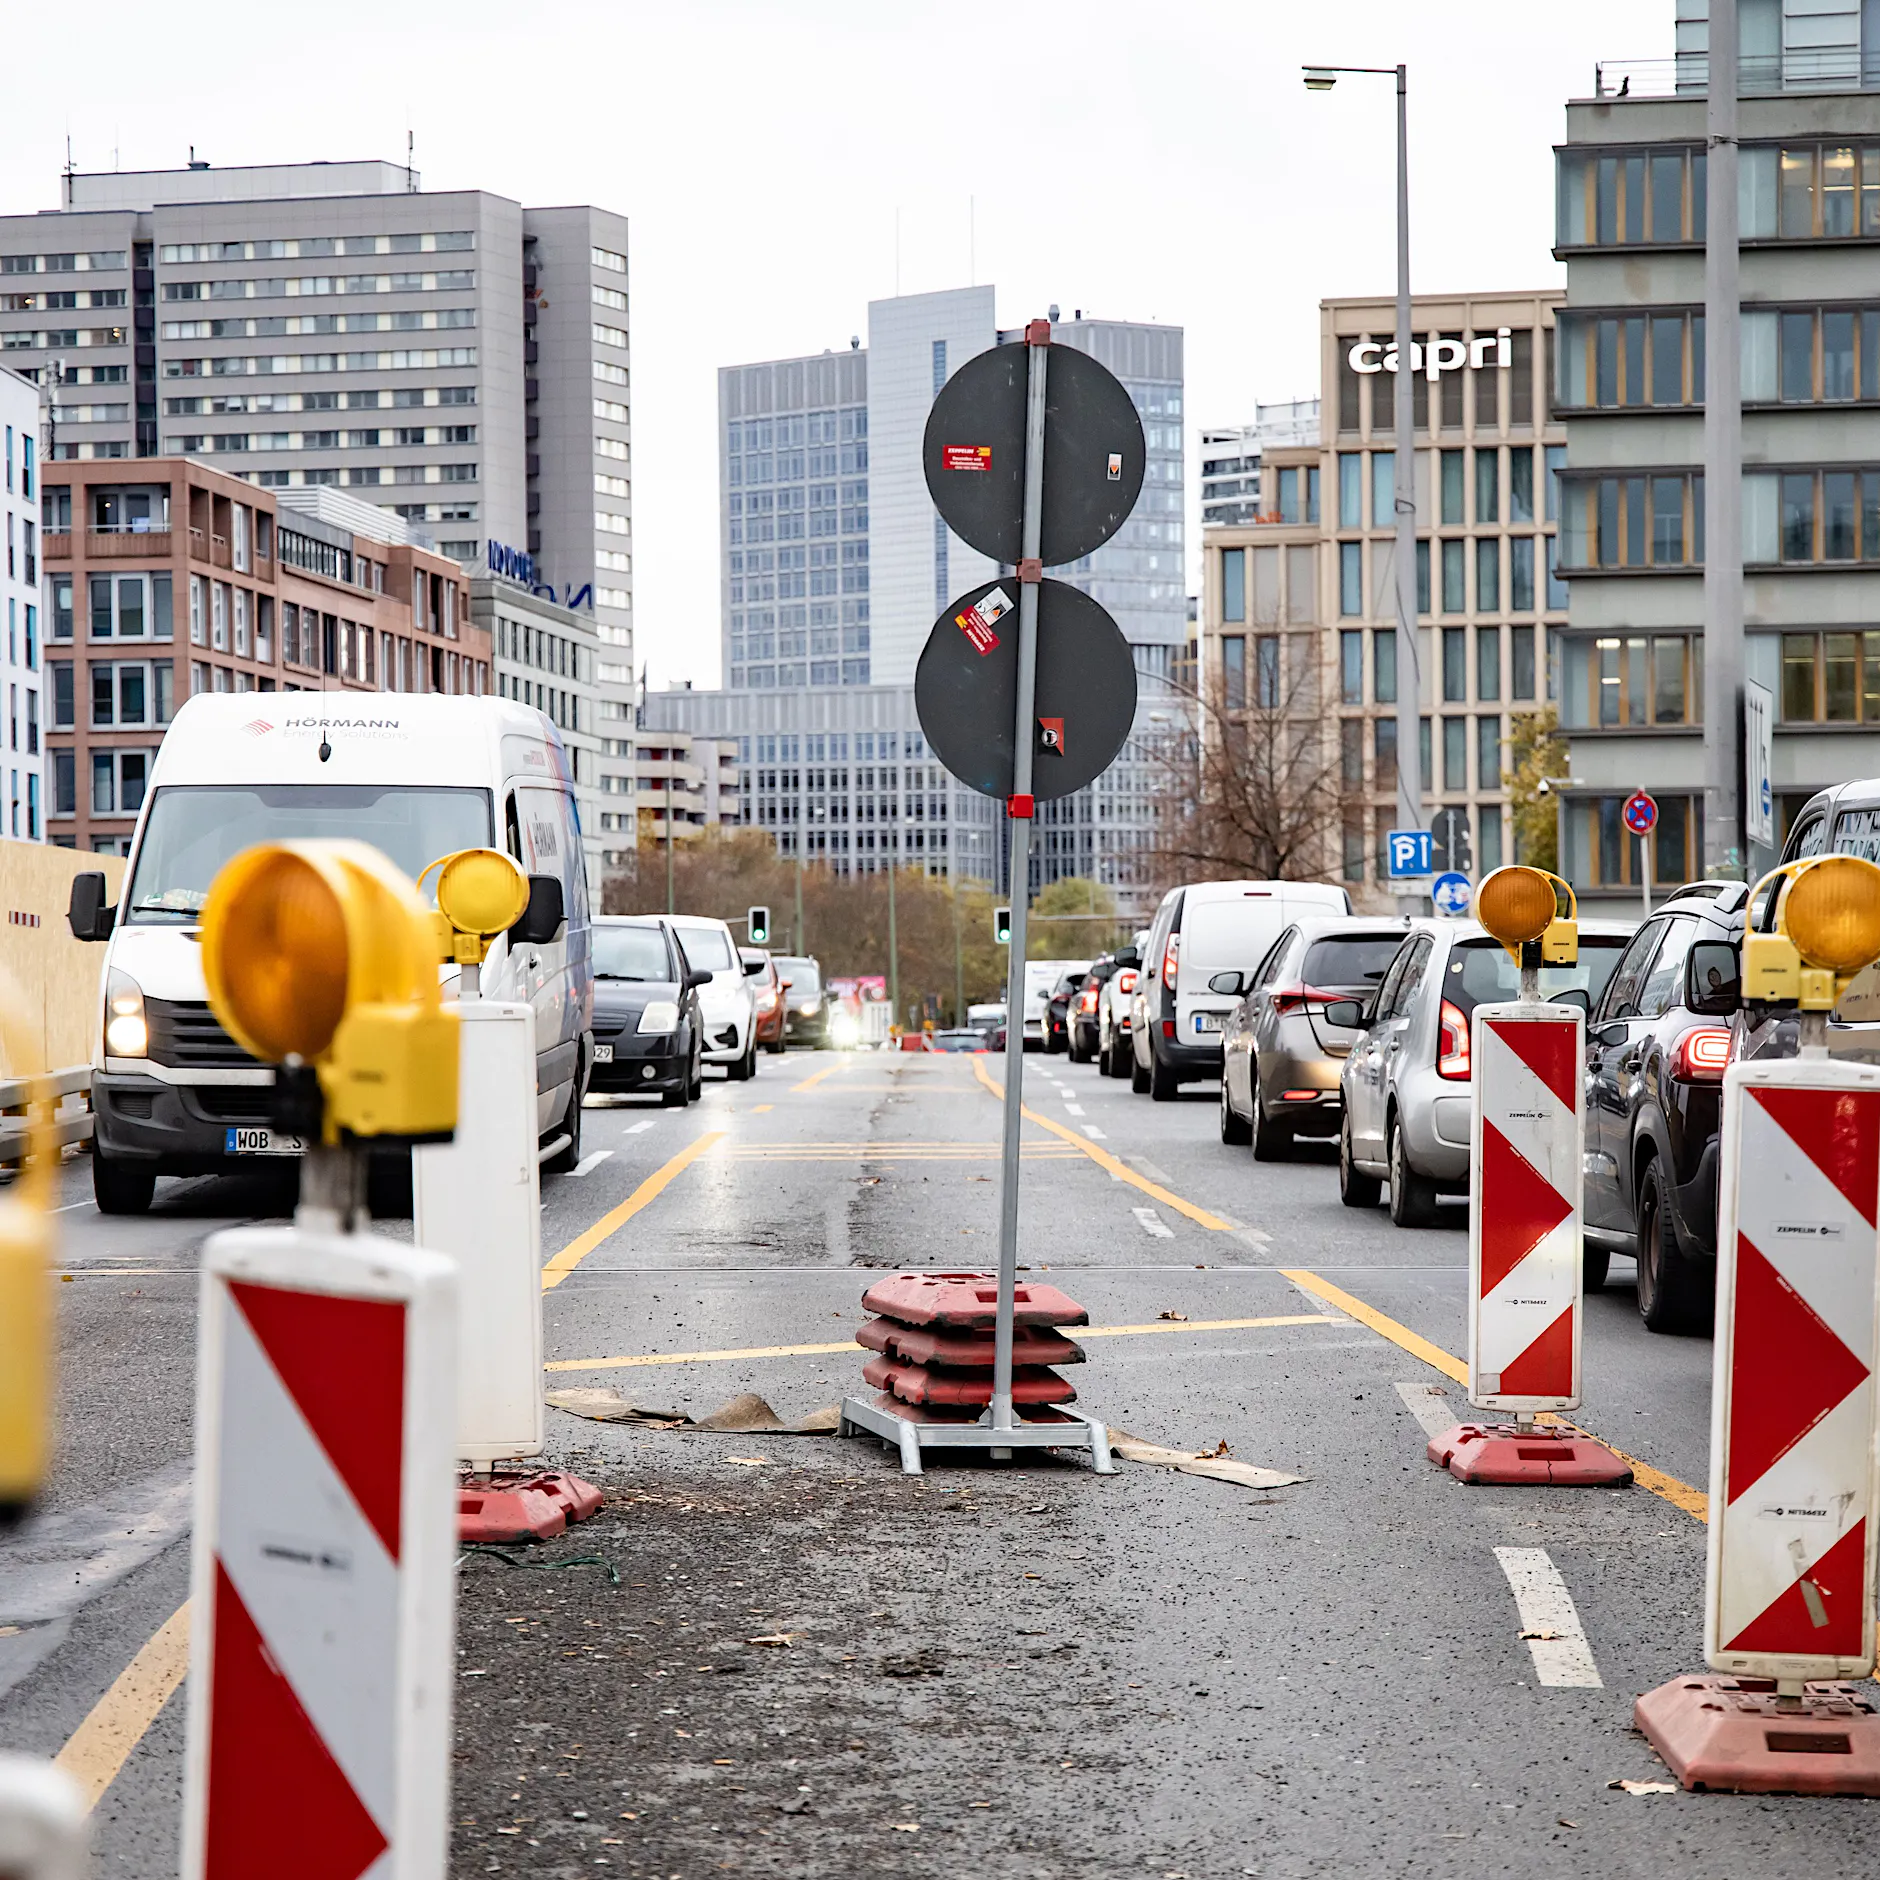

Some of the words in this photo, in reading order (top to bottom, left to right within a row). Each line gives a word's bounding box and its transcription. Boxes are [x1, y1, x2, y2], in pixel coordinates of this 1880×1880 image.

[1348, 327, 1511, 382] capri
[286, 717, 400, 729] HÖRMANN
[594, 1047, 611, 1059] 29
[238, 1131, 268, 1149] WOB
[1777, 1226, 1817, 1234] ZEPPELIN
[1788, 1509, 1828, 1517] ZEPPELIN
